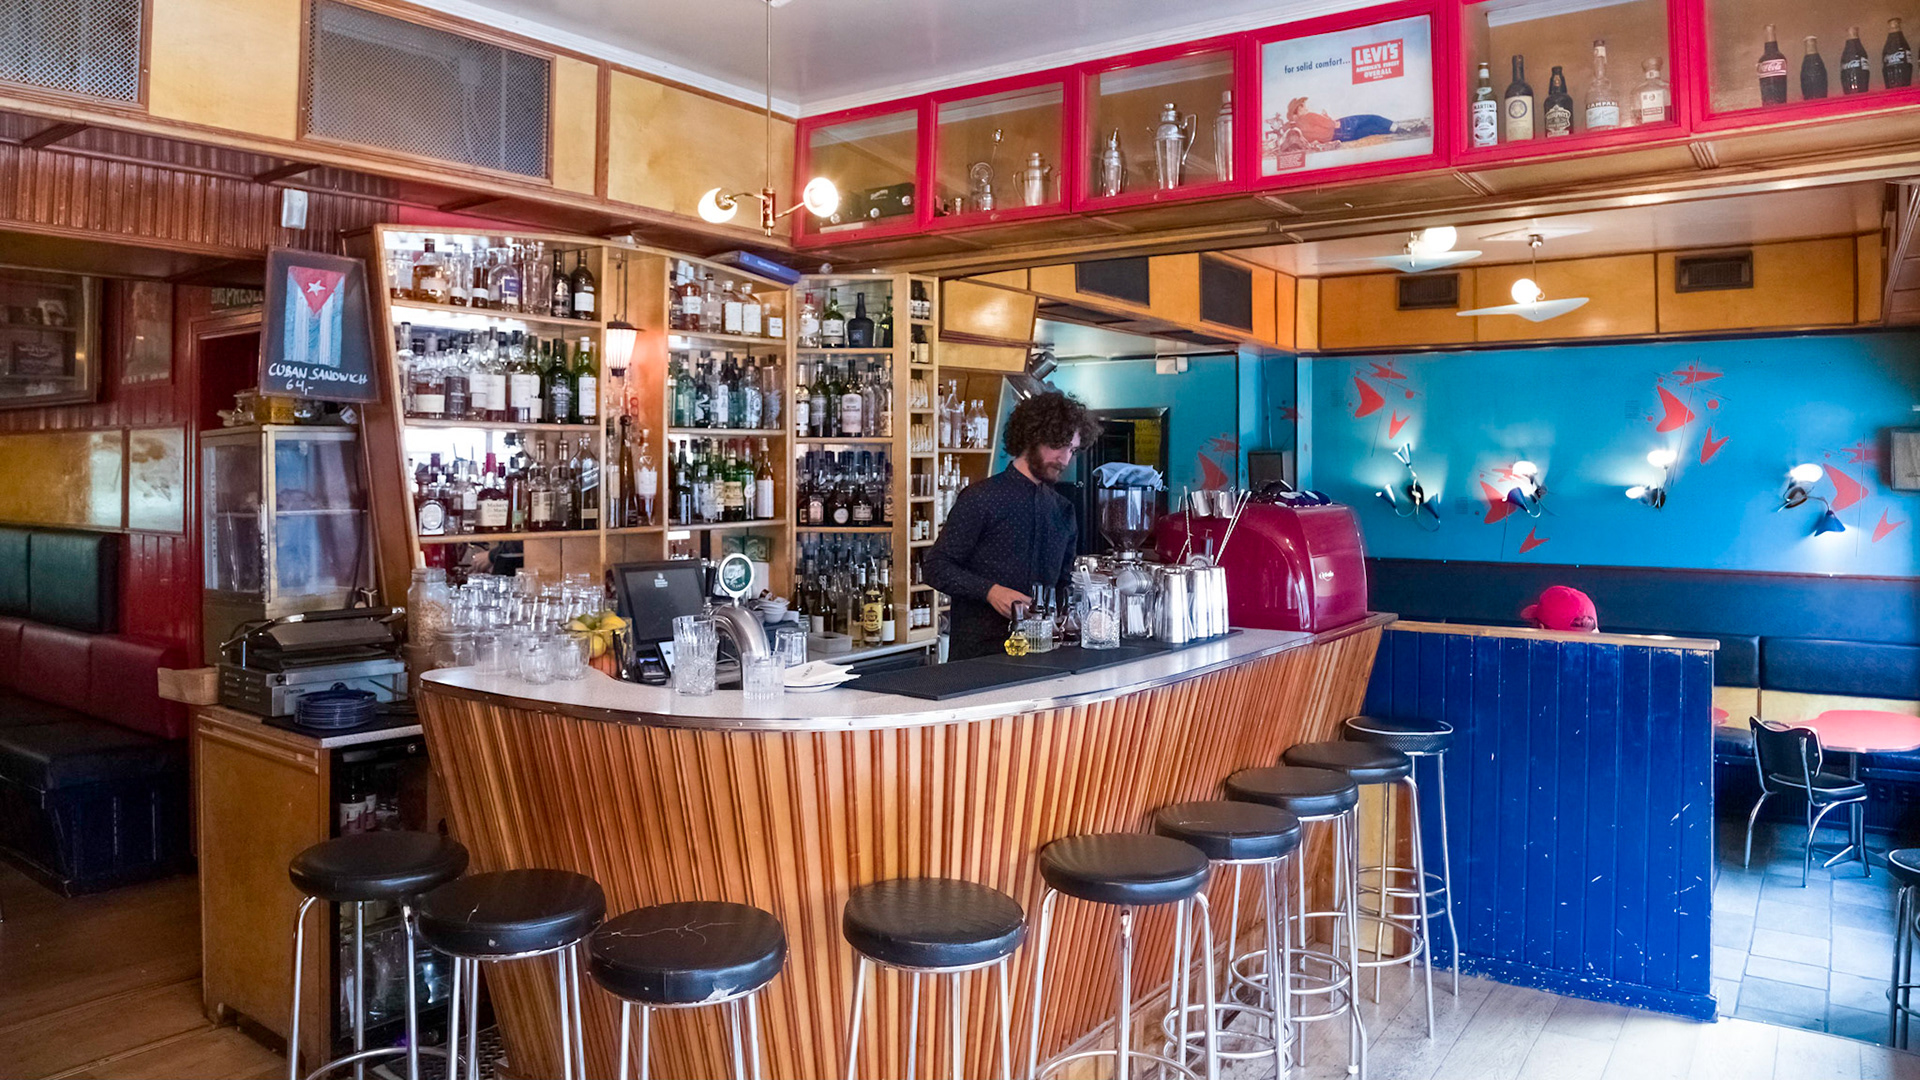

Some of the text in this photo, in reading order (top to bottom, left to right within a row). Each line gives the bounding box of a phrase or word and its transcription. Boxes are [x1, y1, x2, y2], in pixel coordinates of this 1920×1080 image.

[1355, 43, 1399, 66] LEVI'S
[1284, 65, 1295, 74] for
[1296, 61, 1313, 72] solid
[1364, 68, 1393, 78] OVERALL
[268, 362, 368, 385] CUBAN SANDWICH
